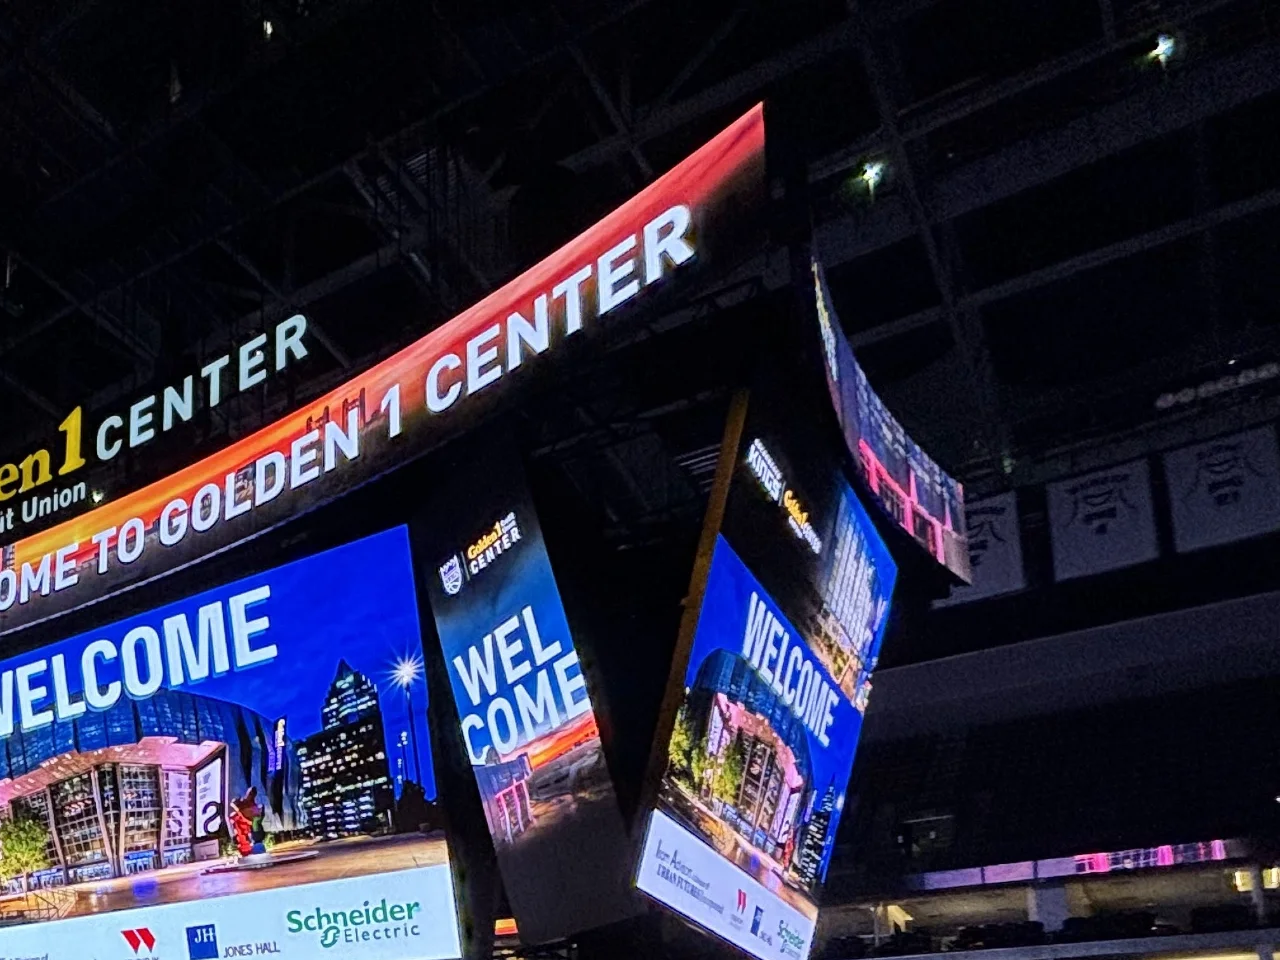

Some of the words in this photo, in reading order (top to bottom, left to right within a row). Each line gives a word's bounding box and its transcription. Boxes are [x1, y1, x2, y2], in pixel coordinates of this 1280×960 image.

[91, 517, 145, 574] TO
[159, 407, 360, 547] GOLDEN
[380, 383, 402, 438] 1
[425, 203, 695, 414] CENTER
[96, 314, 308, 461] CENTER
[21, 482, 87, 524] Union
[470, 527, 522, 575] CENTER
[452, 605, 563, 707] WEL
[742, 591, 840, 747] WELCOME
[461, 650, 592, 766] COME
[194, 927, 215, 943] JH
[286, 899, 421, 933] Schneider
[344, 923, 421, 943] Electric
[223, 944, 253, 959] JONES
[256, 940, 281, 955] HALL
